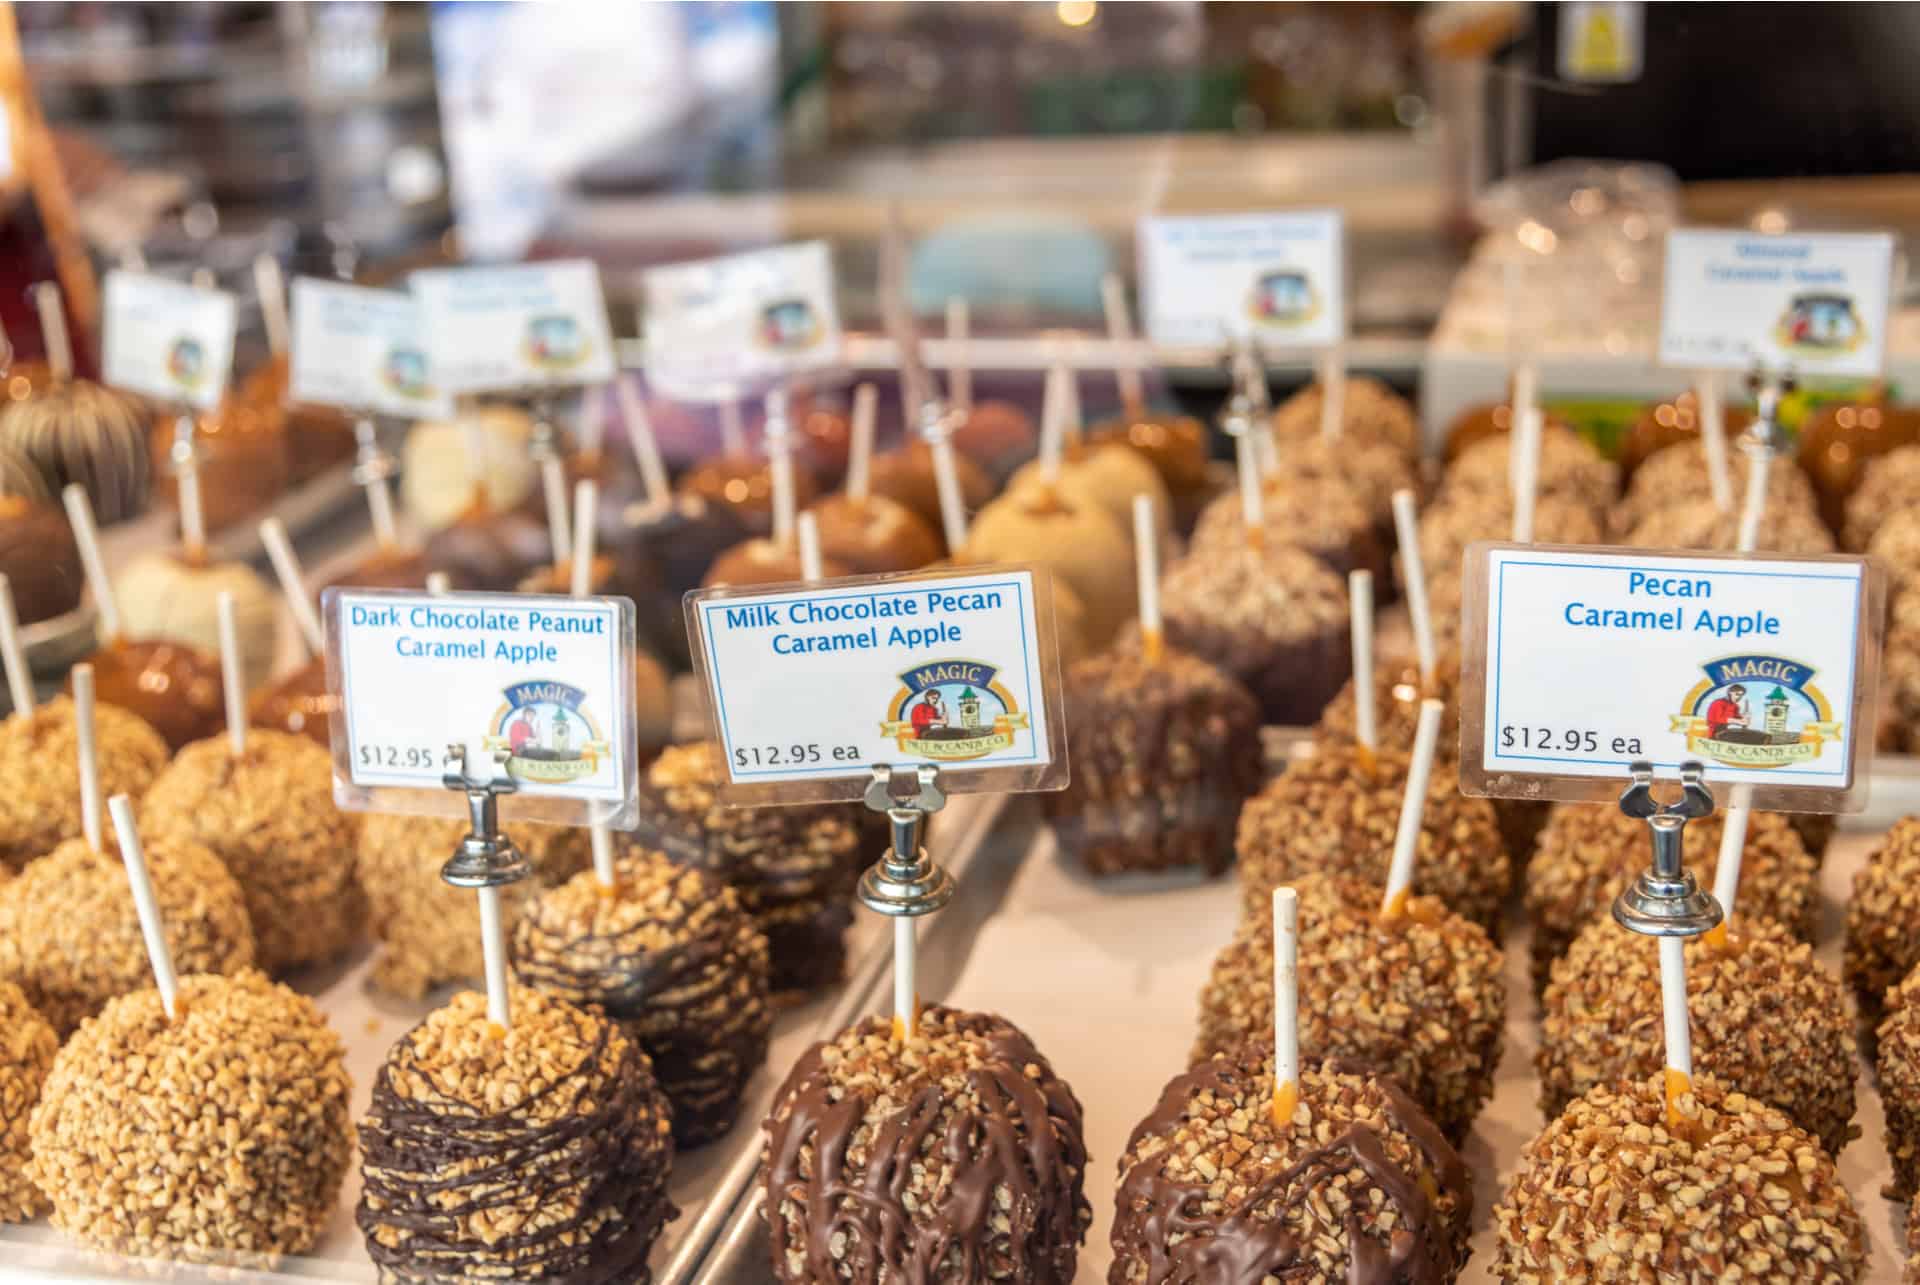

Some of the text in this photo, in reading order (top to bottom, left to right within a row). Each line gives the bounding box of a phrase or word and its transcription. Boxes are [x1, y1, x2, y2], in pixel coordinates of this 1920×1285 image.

[1629, 572, 1711, 598] Pecan
[352, 606, 604, 634] Dark Chocolate Peanut
[726, 591, 1001, 629] Milk Chocolate Pecan
[1565, 602, 1779, 638] Caramel Apple
[397, 637, 557, 664] Caramel Apple
[772, 622, 961, 655] Caramel Apple
[916, 664, 981, 688] MAGIC
[1720, 660, 1797, 683] MAGIC
[1502, 726, 1642, 754] $12.95 ea
[360, 744, 432, 768] $12.95
[735, 744, 860, 767] $12.95 ea
